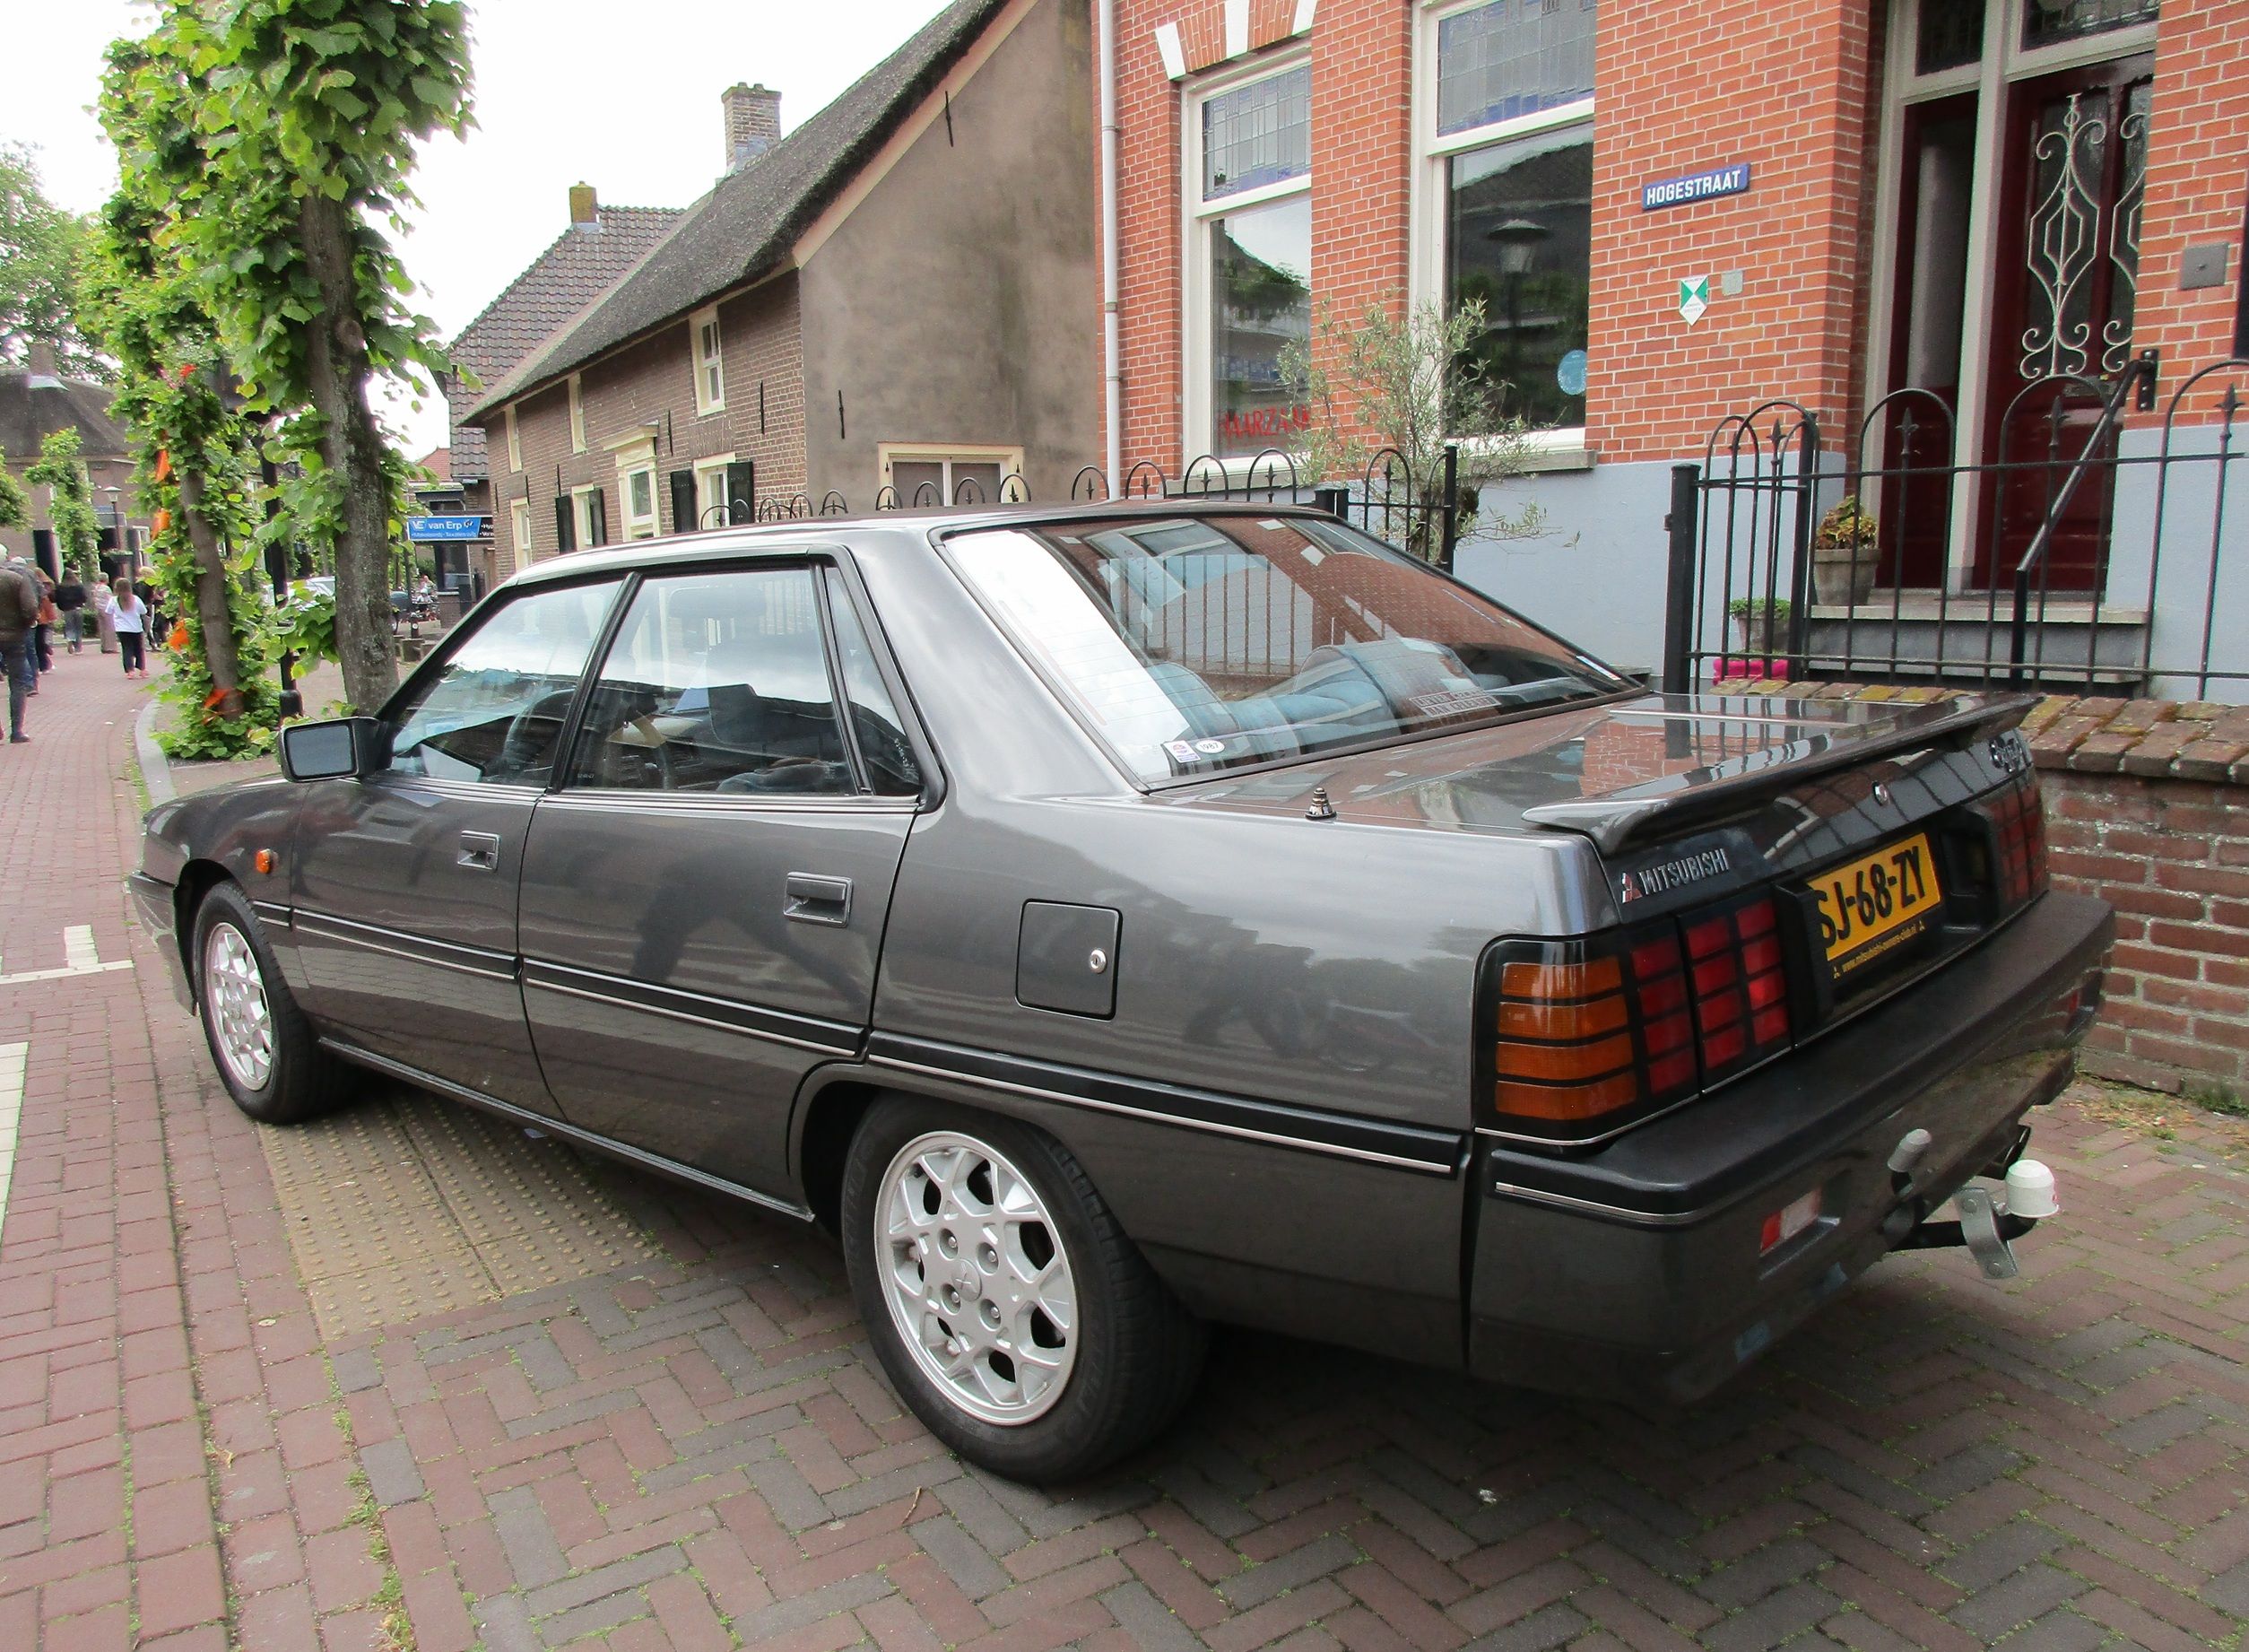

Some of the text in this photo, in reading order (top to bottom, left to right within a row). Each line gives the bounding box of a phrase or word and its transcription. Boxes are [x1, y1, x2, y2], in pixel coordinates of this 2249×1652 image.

[1646, 170, 1741, 205] HOGESTRAAT
[446, 521, 463, 531] Erp
[1200, 742, 1219, 751] 1987
[1638, 848, 1729, 895] MITSUBISHI
[1813, 846, 1925, 949] SJ-68-ZY
